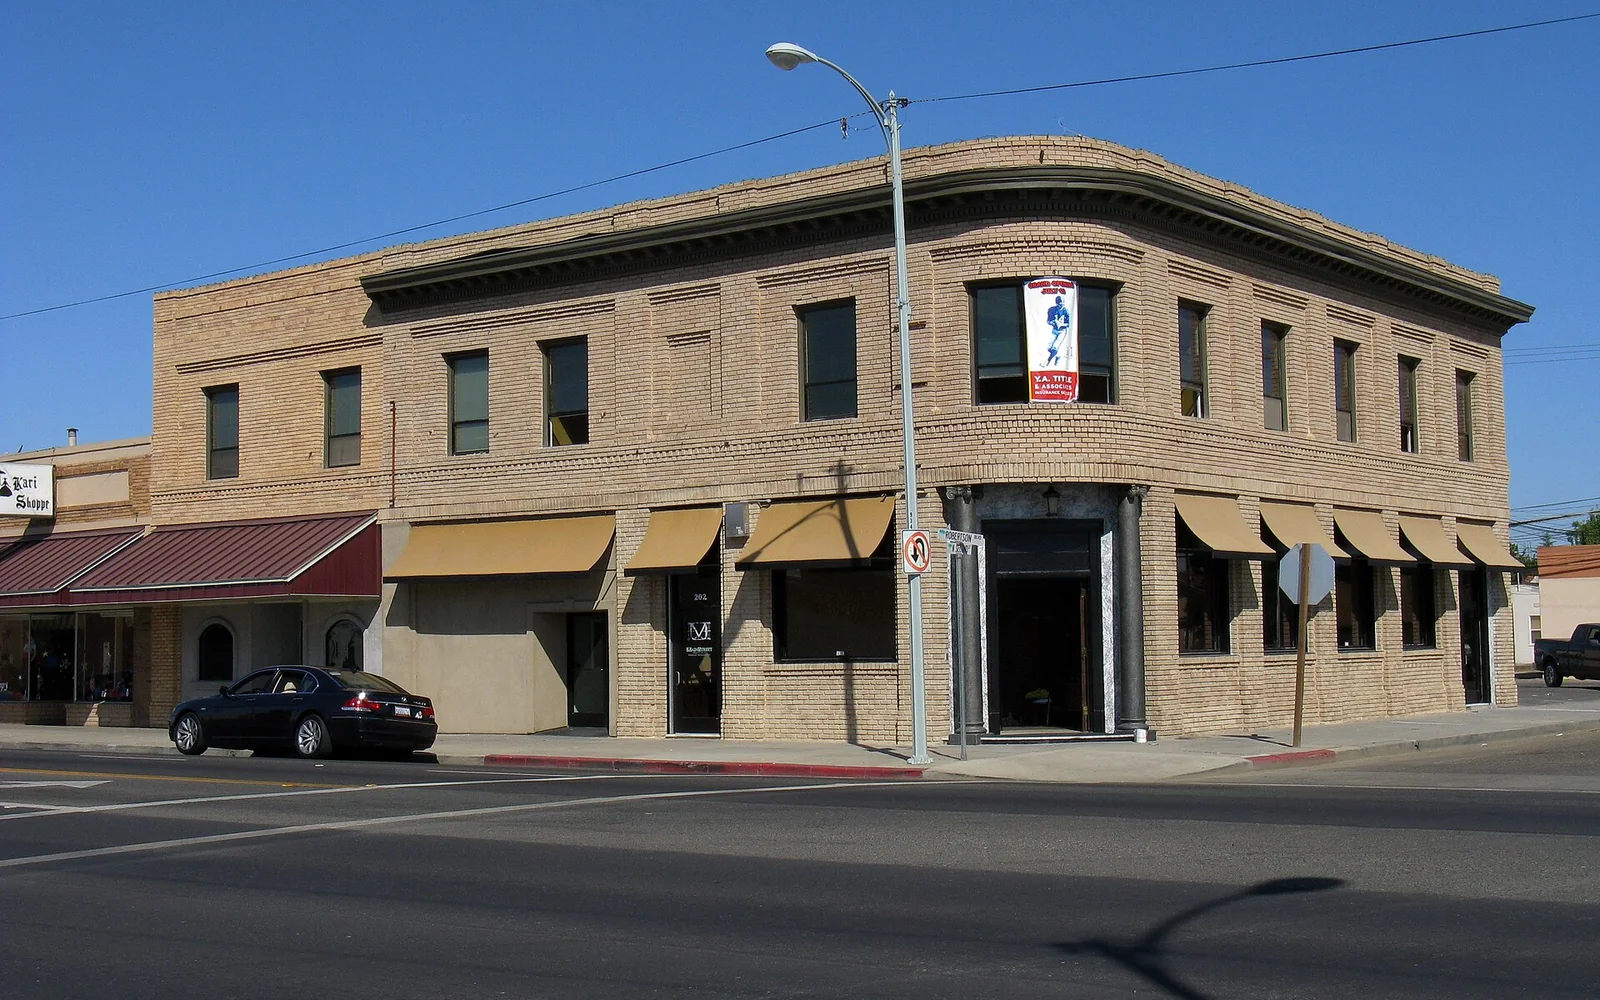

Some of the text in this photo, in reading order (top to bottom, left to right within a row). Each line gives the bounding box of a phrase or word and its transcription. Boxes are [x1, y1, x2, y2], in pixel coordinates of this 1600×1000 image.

[1034, 375, 1051, 383] Y.A.
[12, 476, 37, 491] Kari
[16, 494, 50, 511] Shoppe
[944, 530, 973, 543] ROBERTSON
[693, 593, 708, 601] 202
